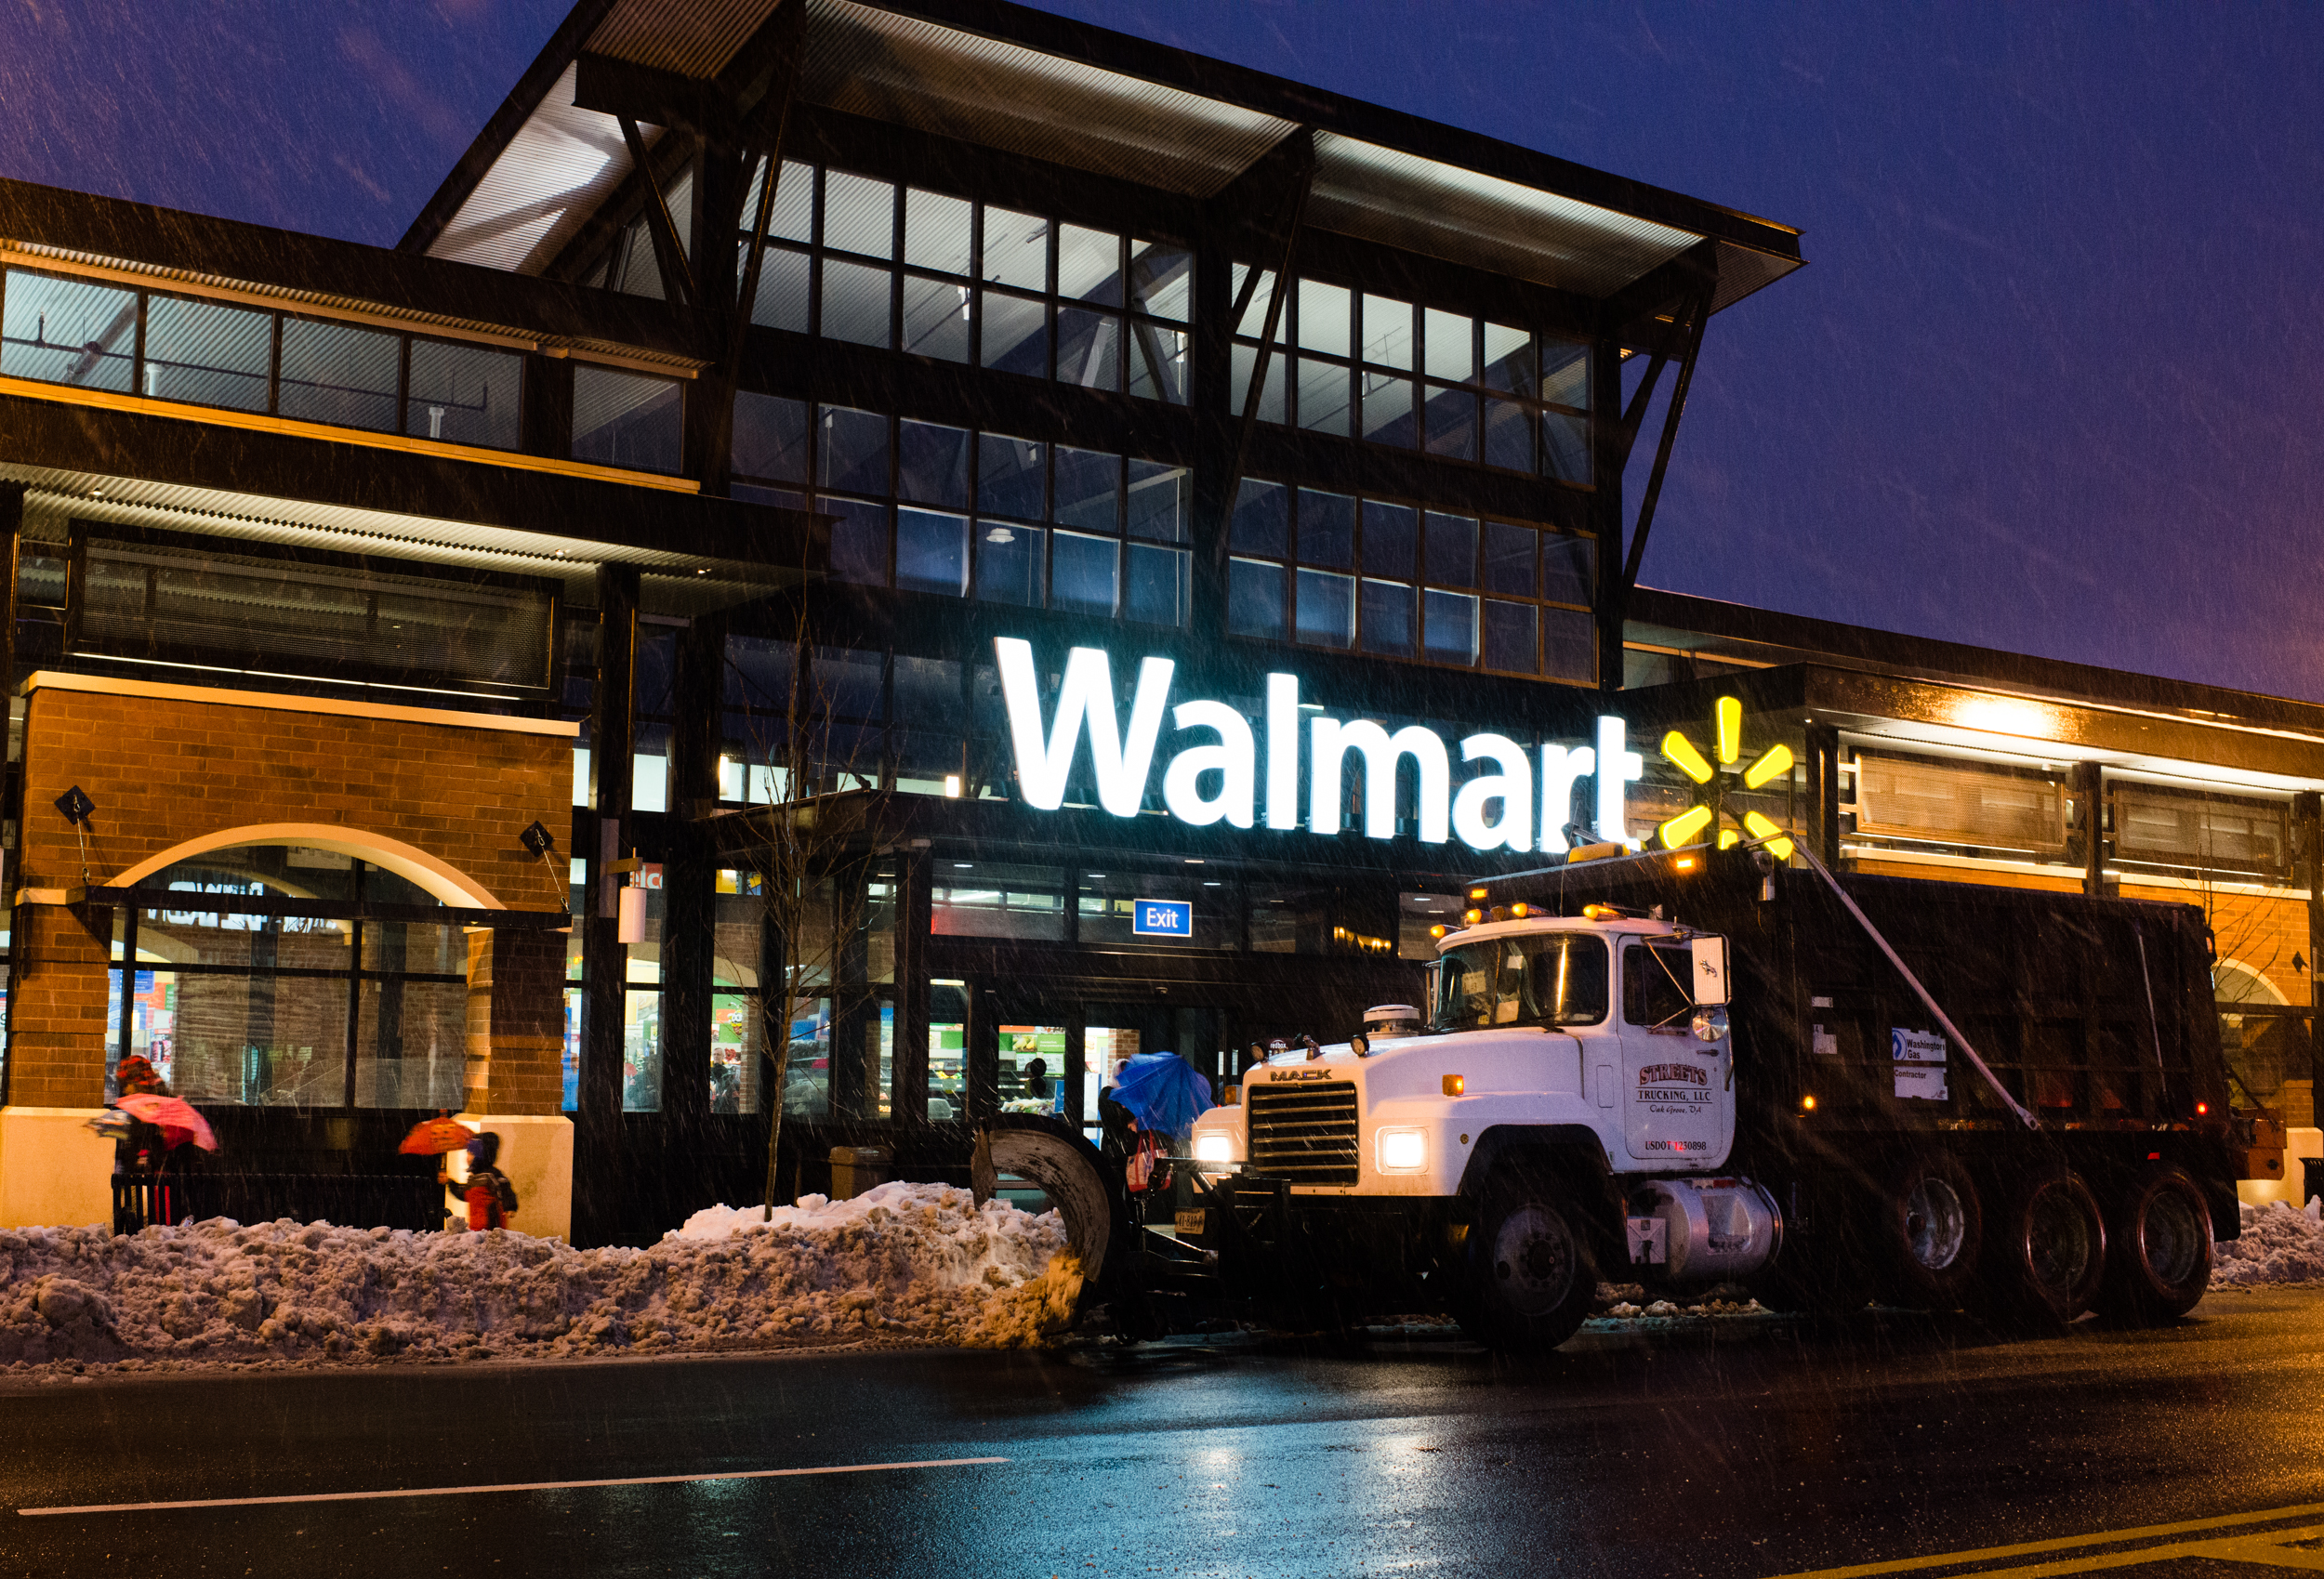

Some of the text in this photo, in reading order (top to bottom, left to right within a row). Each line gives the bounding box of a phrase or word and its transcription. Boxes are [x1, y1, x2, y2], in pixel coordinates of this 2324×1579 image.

[994, 636, 1643, 853] Walmart
[629, 865, 663, 888] elc
[1146, 907, 1178, 928] Exit
[1907, 1038, 1946, 1052] Washington
[1908, 1049, 1921, 1059] Gas
[1270, 1069, 1332, 1082] MACK
[1639, 1062, 1708, 1086] STREETS
[1894, 1069, 1927, 1080] Contractor
[1638, 1090, 1710, 1101] TRUCKING, LLC
[1649, 1104, 1702, 1115] Oak Grove, VA
[1644, 1141, 1707, 1151] USDOT 1230898
